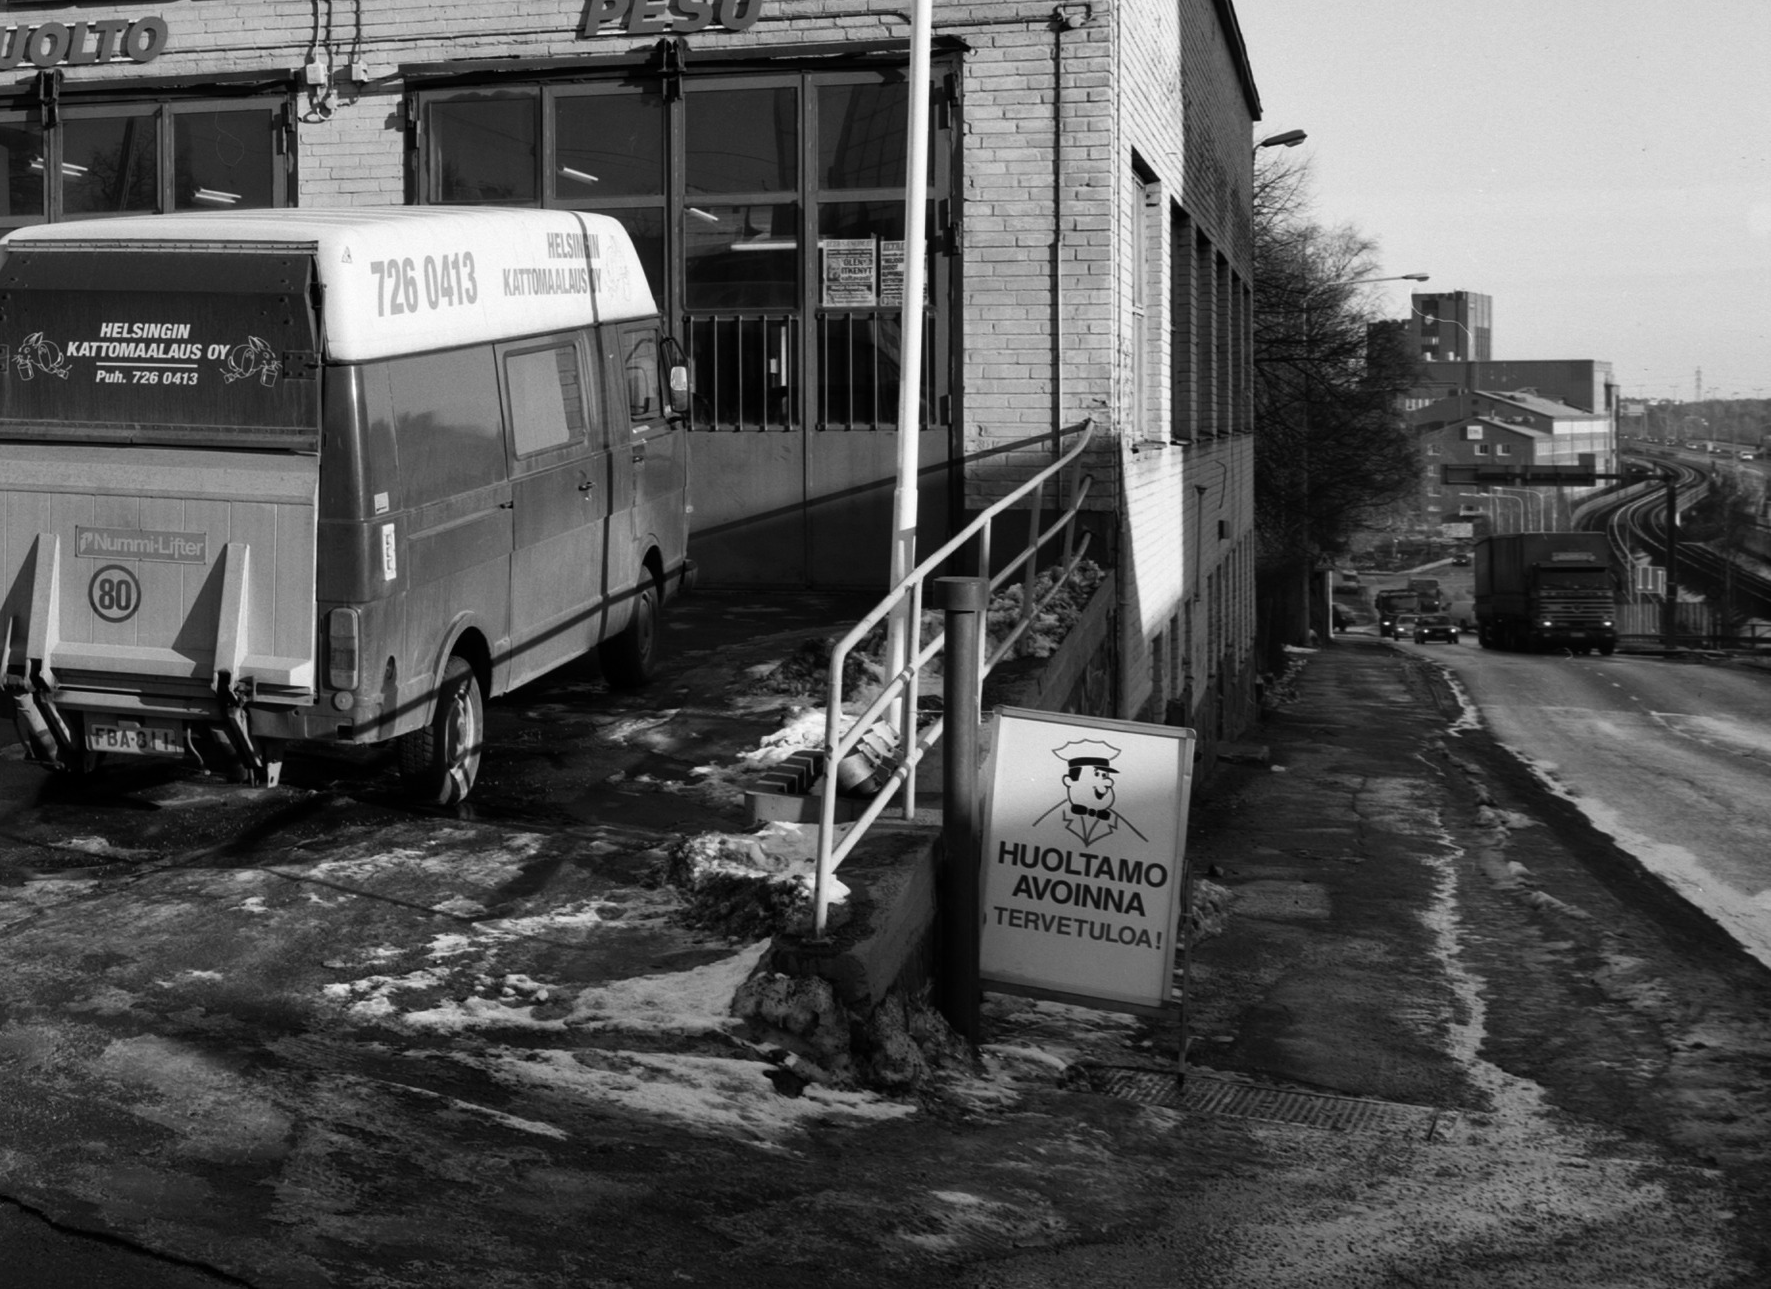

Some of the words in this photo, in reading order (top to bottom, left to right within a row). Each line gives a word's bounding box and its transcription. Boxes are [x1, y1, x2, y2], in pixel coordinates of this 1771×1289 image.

[546, 232, 600, 259] HELSINGIN
[370, 257, 418, 317] 726
[424, 251, 477, 310] 0413
[503, 268, 587, 296] KATTOMAALAUS
[100, 322, 191, 339] HELSINGIN
[66, 341, 202, 359] KATTOMAALAUS
[207, 344, 231, 360] OY
[95, 370, 127, 383] Puh.
[132, 371, 159, 384] 726
[162, 372, 198, 385] 0413
[94, 532, 204, 559] Nummi-Lifter
[98, 578, 132, 611] 80
[998, 841, 1168, 888] HUOLTAMO
[1012, 875, 1146, 917] AVOINNA
[993, 906, 1163, 951] TERVETULOA!
